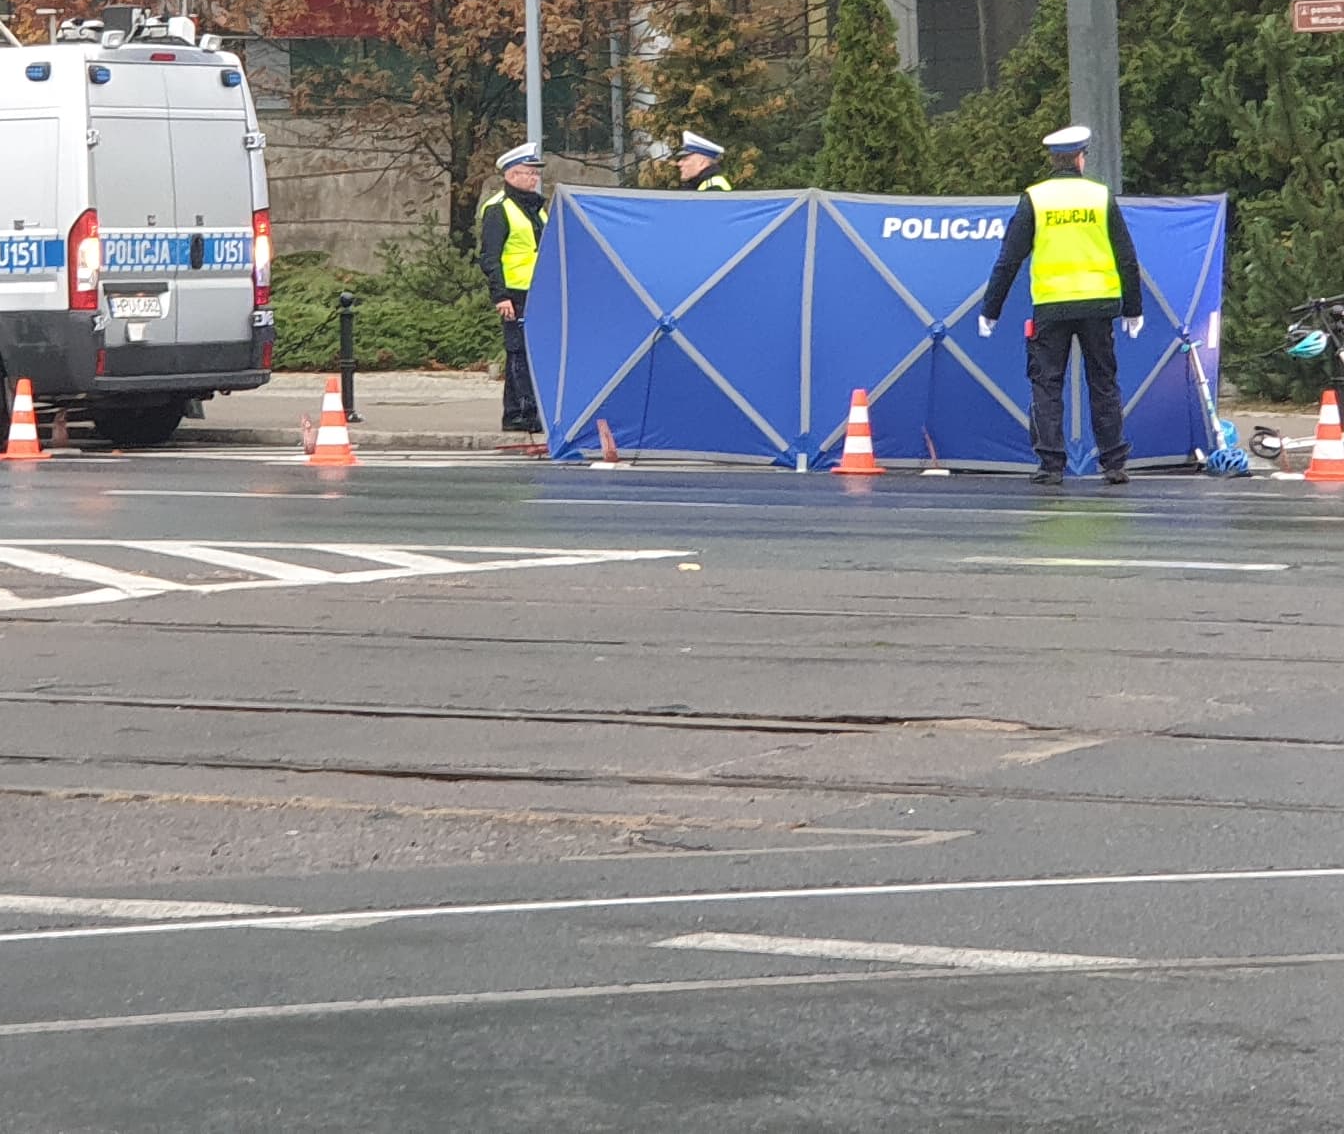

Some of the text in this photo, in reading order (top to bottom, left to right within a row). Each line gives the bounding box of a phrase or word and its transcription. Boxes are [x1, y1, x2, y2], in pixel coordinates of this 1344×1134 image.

[882, 217, 1006, 240] POLICJA
[1045, 209, 1097, 227] POLICJA
[107, 240, 243, 265] POLICJA U151
